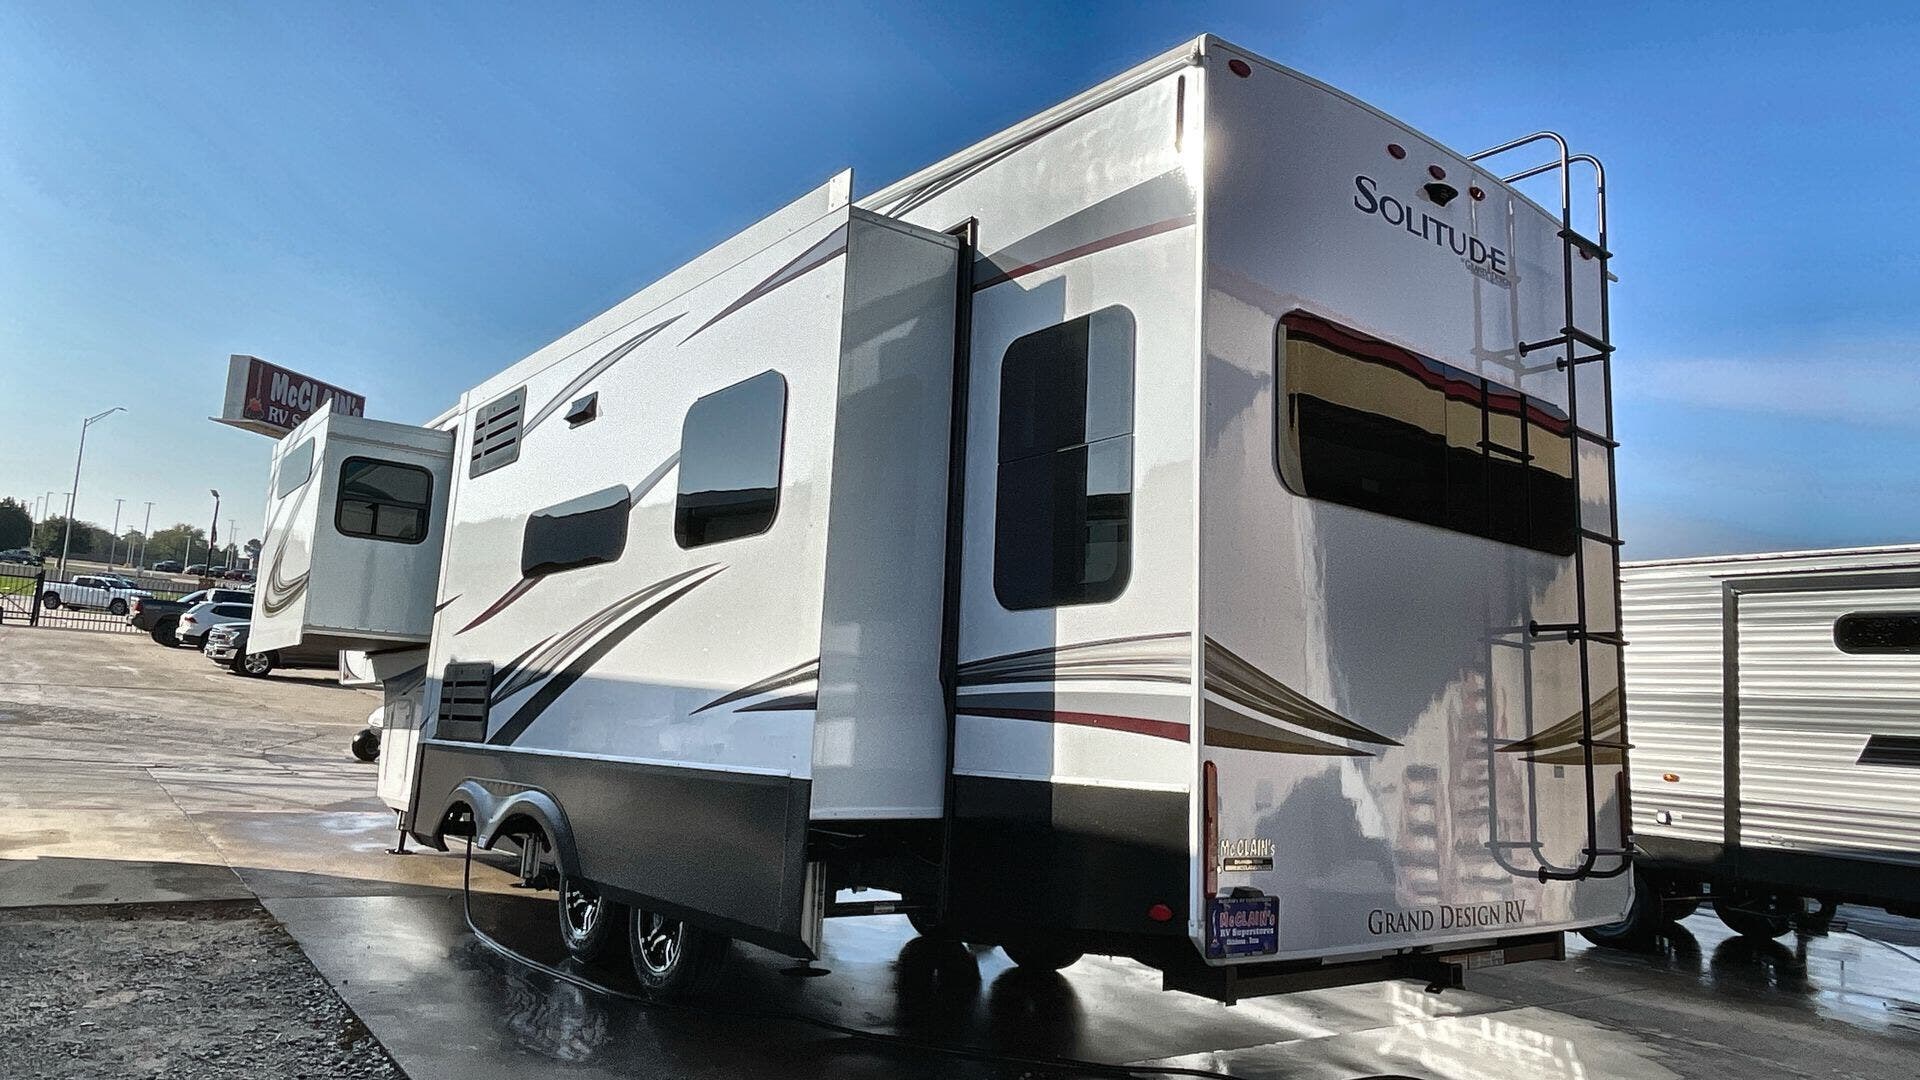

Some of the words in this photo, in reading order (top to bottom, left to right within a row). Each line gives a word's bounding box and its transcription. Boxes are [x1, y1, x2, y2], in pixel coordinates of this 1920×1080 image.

[1354, 175, 1507, 276] SOLITUDE
[268, 405, 289, 425] RV
[1368, 909, 1434, 935] GRAND
[1440, 905, 1500, 929] DESIGN
[1504, 899, 1526, 923] RV
